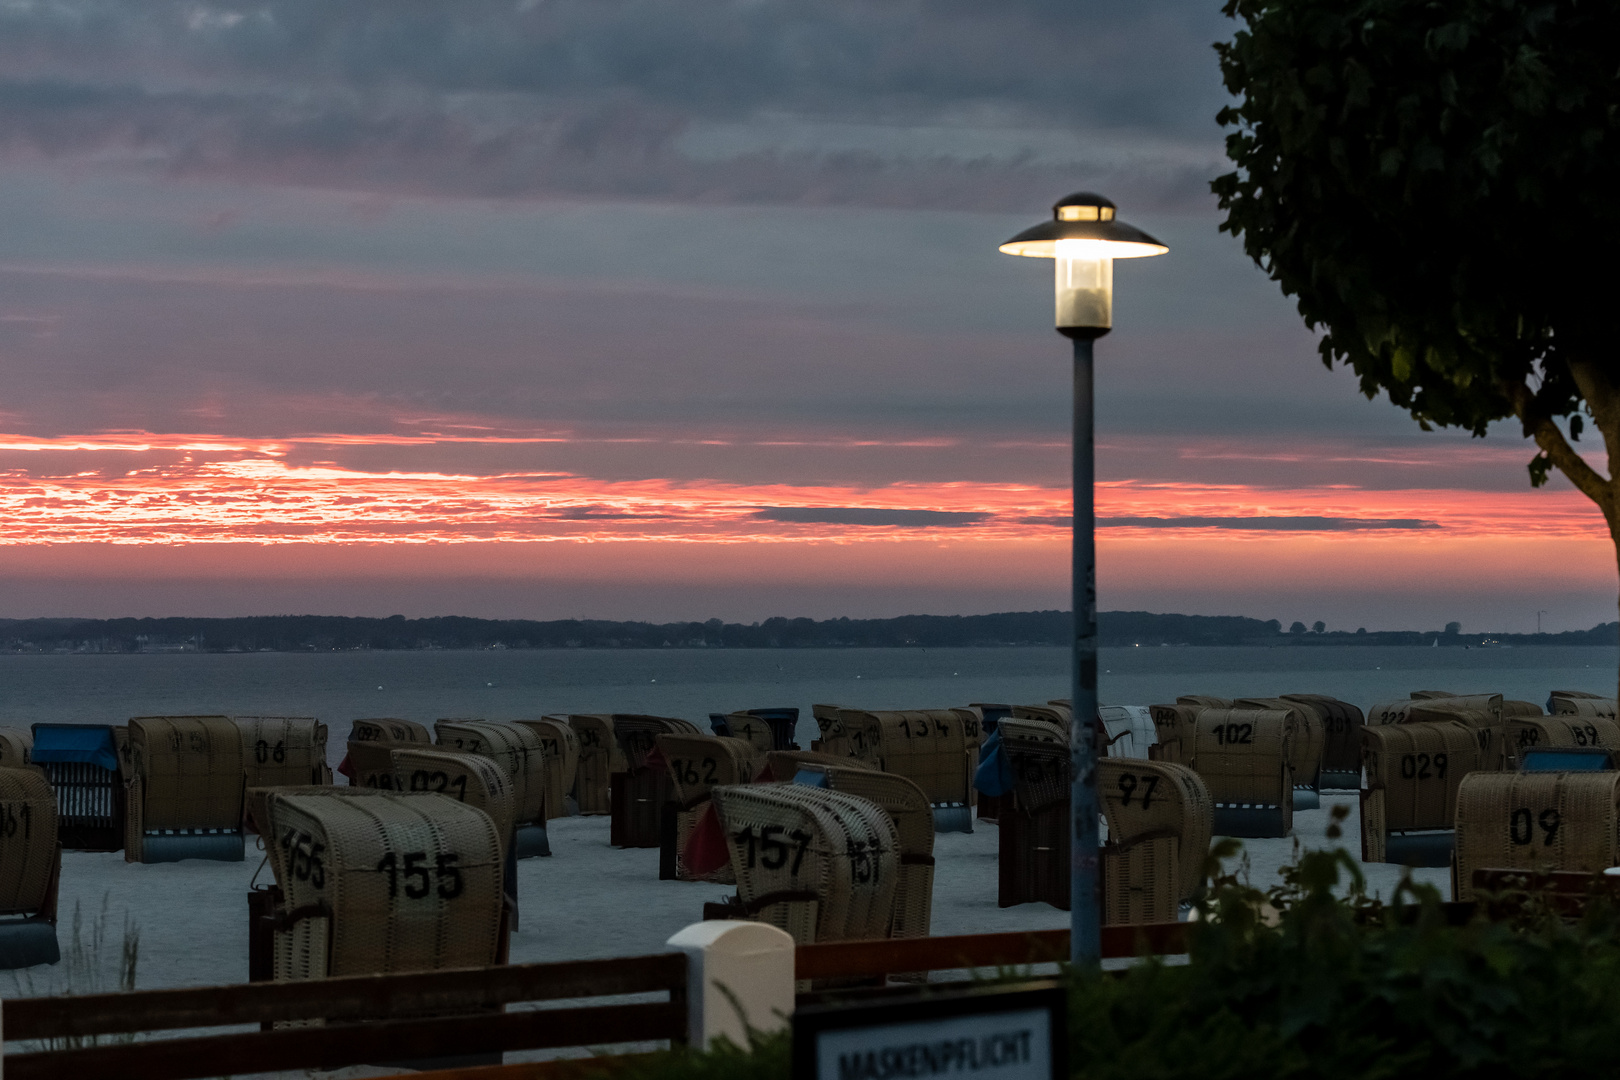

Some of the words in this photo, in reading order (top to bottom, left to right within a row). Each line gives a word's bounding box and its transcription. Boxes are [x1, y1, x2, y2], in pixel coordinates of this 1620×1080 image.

[898, 718, 949, 739] 134
[1212, 722, 1252, 746] 102
[254, 739, 285, 764] 06
[1401, 752, 1447, 780] 029
[408, 769, 465, 802] 021
[671, 757, 718, 786] 162
[1118, 772, 1160, 810] 97
[1510, 807, 1561, 847] 09
[734, 825, 812, 877] 157
[376, 851, 462, 900] 155
[837, 1029, 1032, 1080] MASKENPFLICHT
